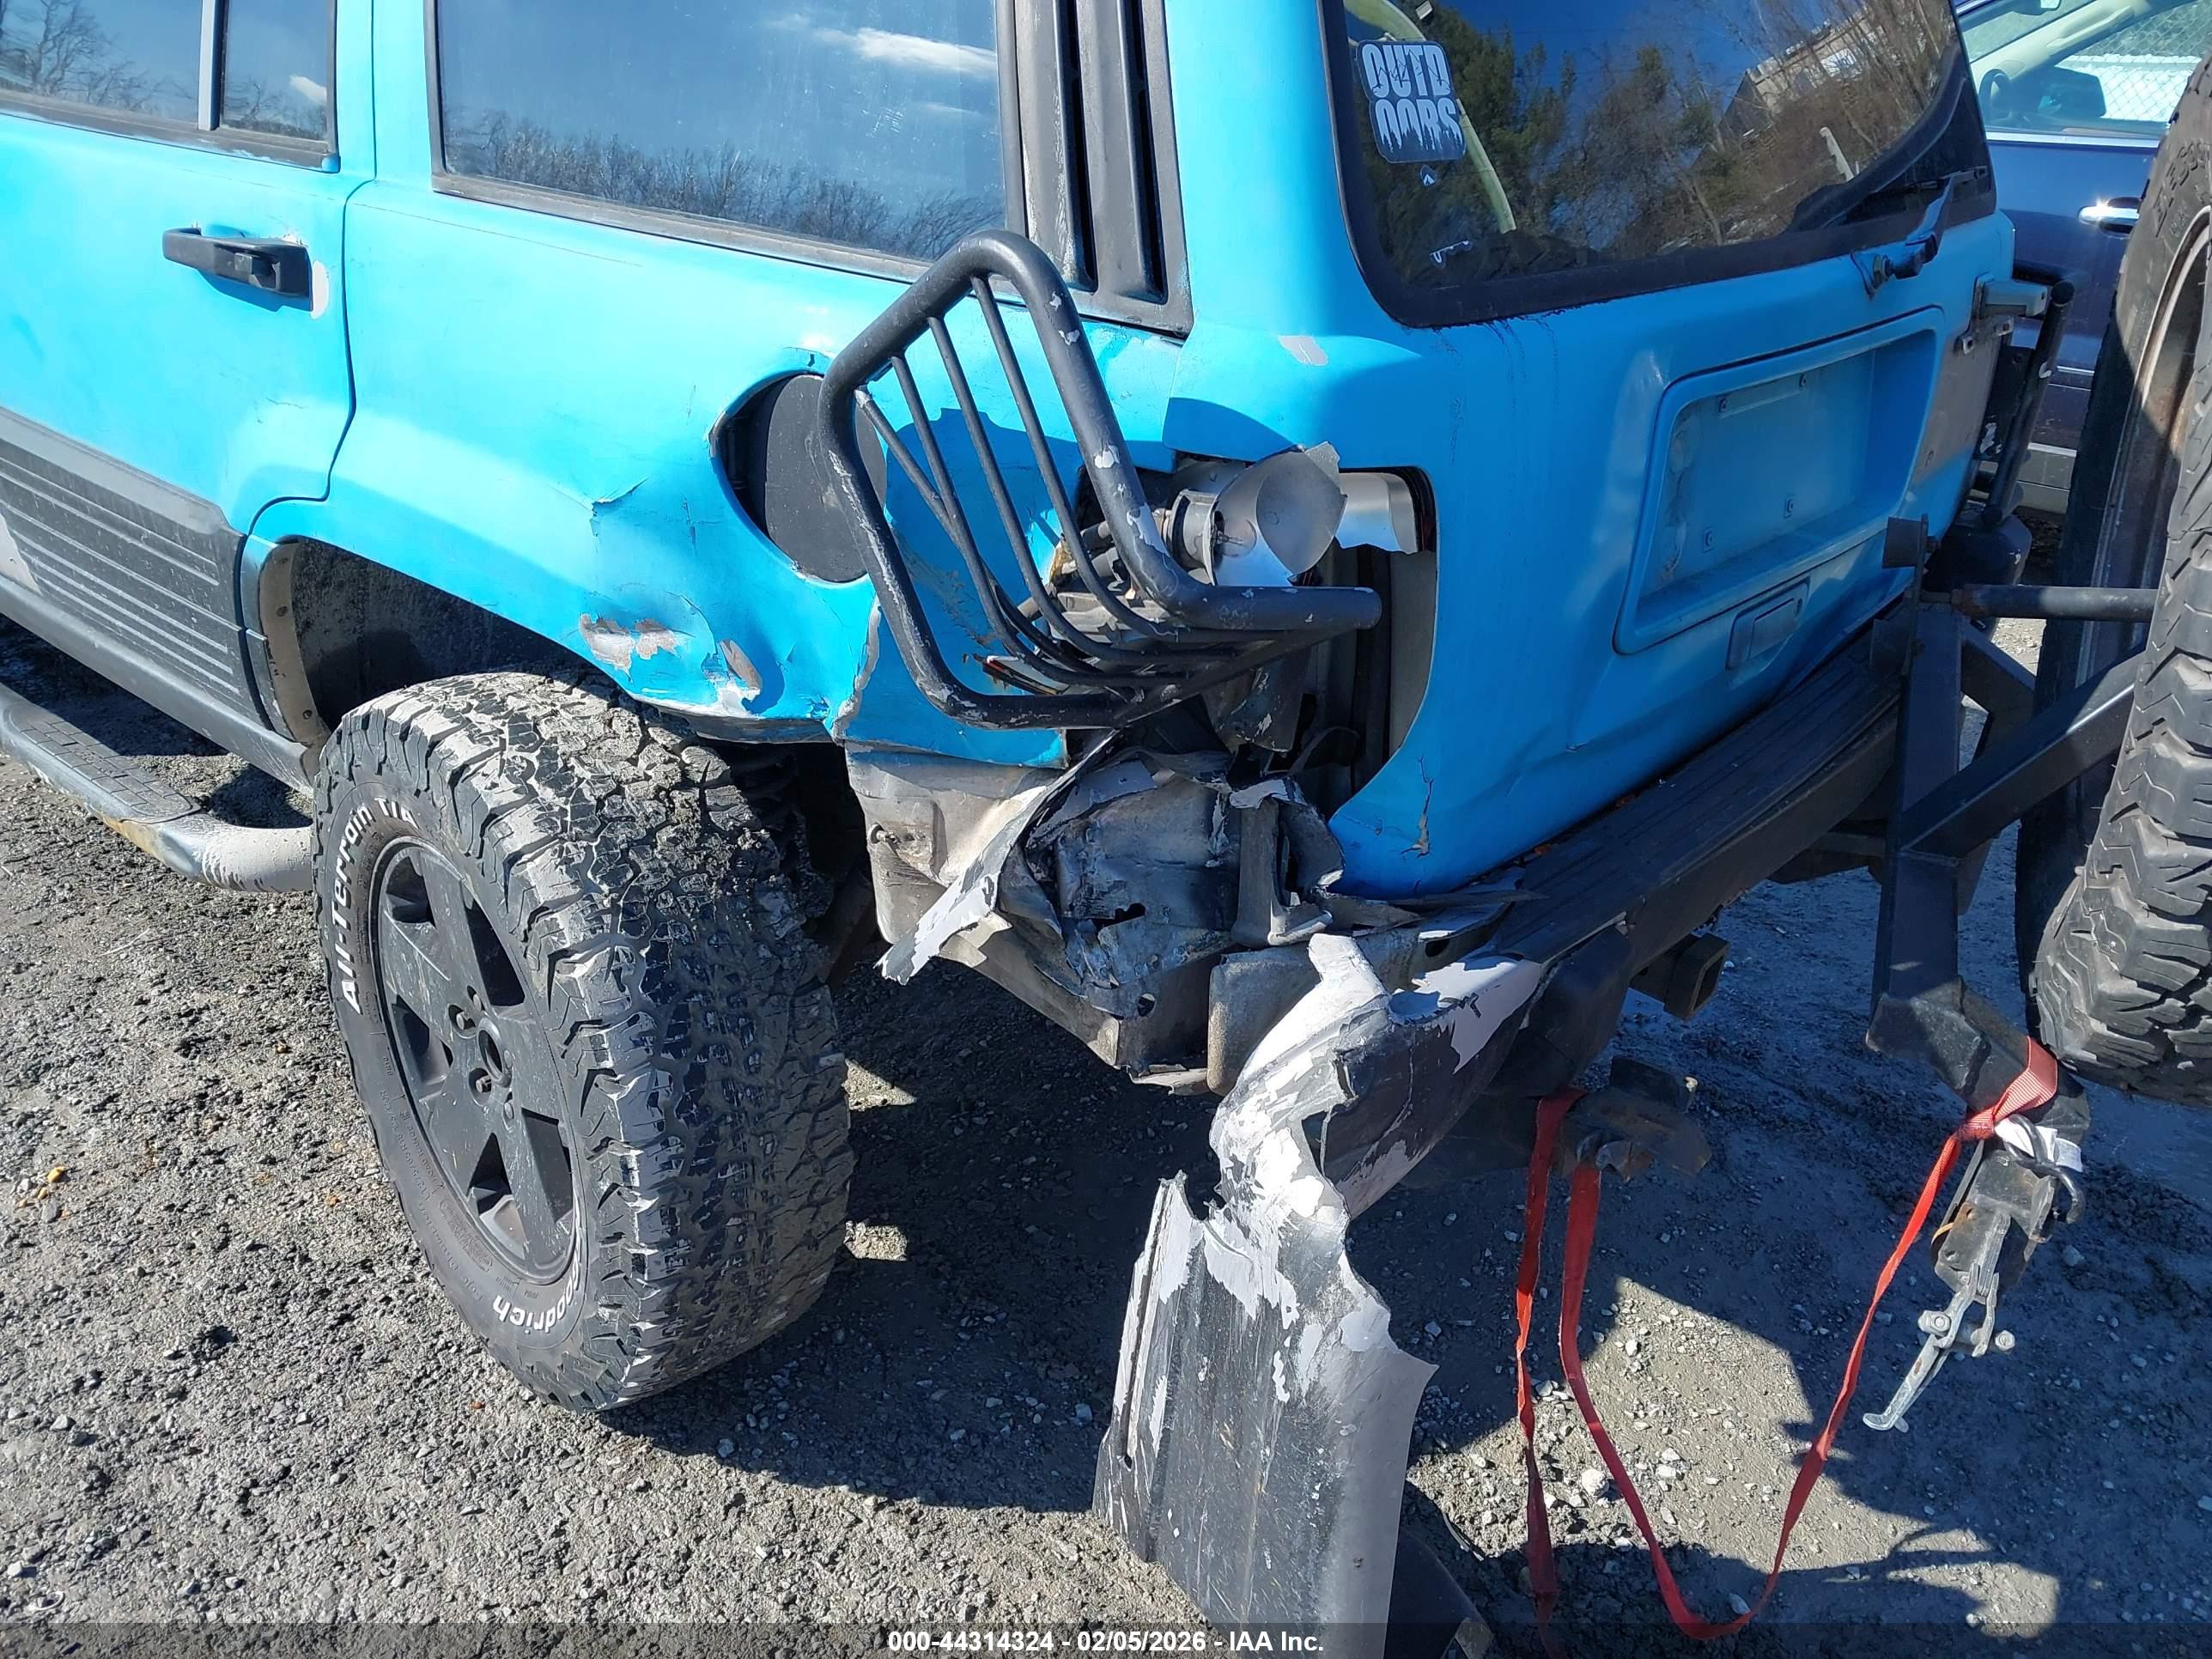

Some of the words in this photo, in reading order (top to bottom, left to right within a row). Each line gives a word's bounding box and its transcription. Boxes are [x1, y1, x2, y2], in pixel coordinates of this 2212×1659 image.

[1362, 43, 1451, 98] OUTD
[1375, 97, 1463, 152] OORS
[331, 803, 374, 1015] All-Terrain
